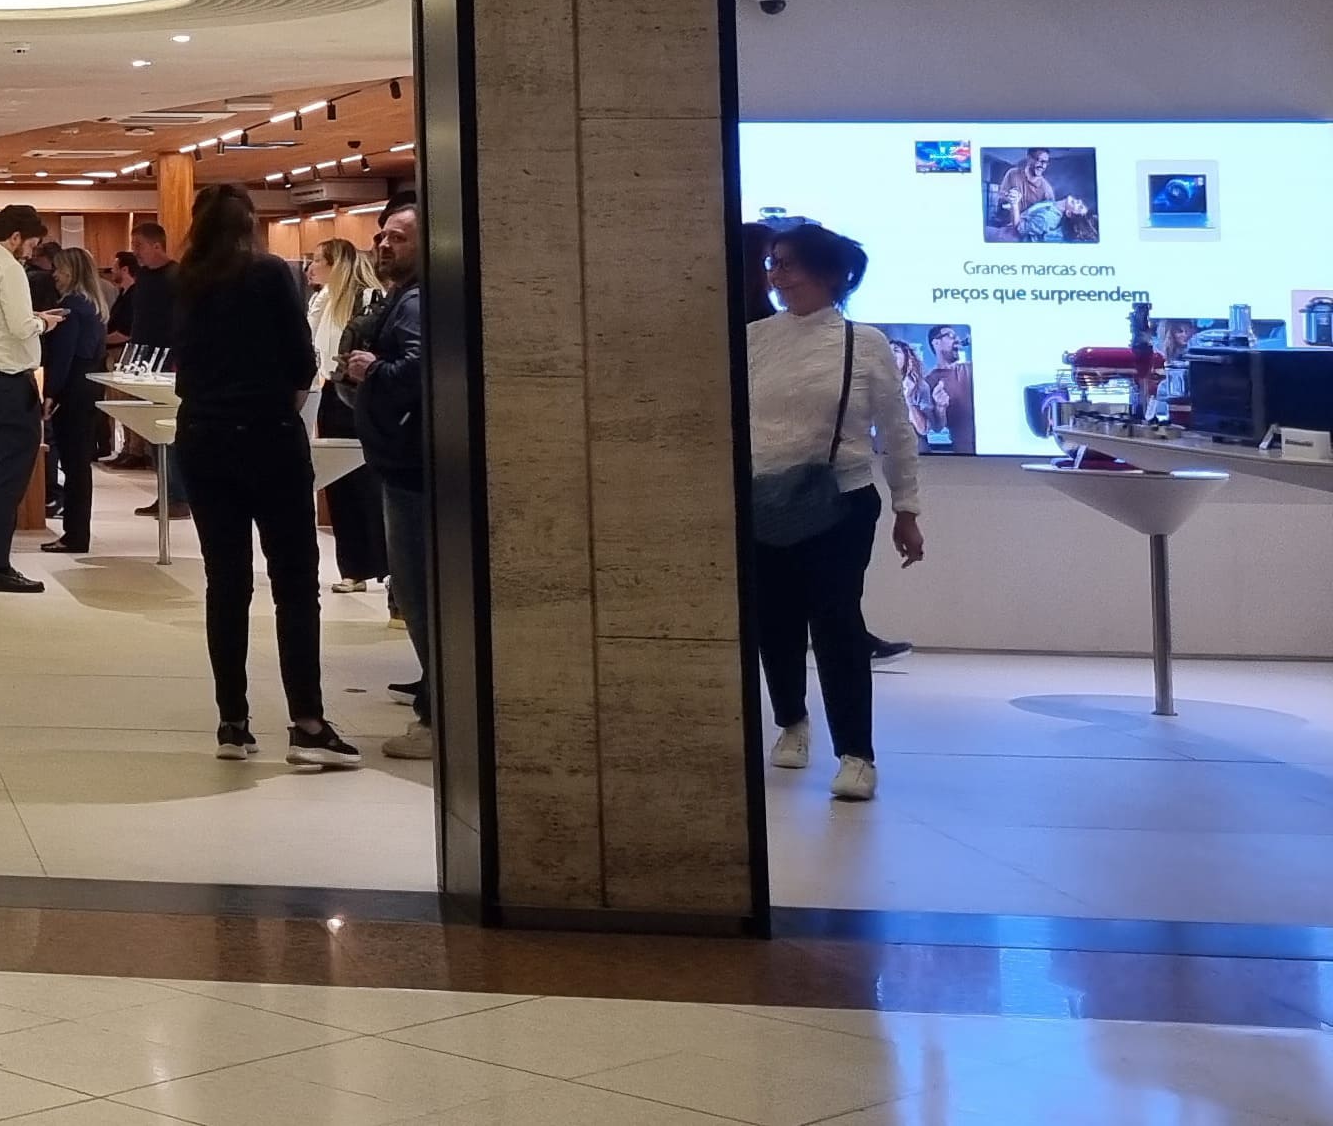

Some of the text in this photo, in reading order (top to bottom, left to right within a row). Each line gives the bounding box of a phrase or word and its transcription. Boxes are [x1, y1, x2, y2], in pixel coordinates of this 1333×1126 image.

[963, 260, 1116, 277] Granes marcas com
[932, 286, 1150, 305] preços que surpreendem
